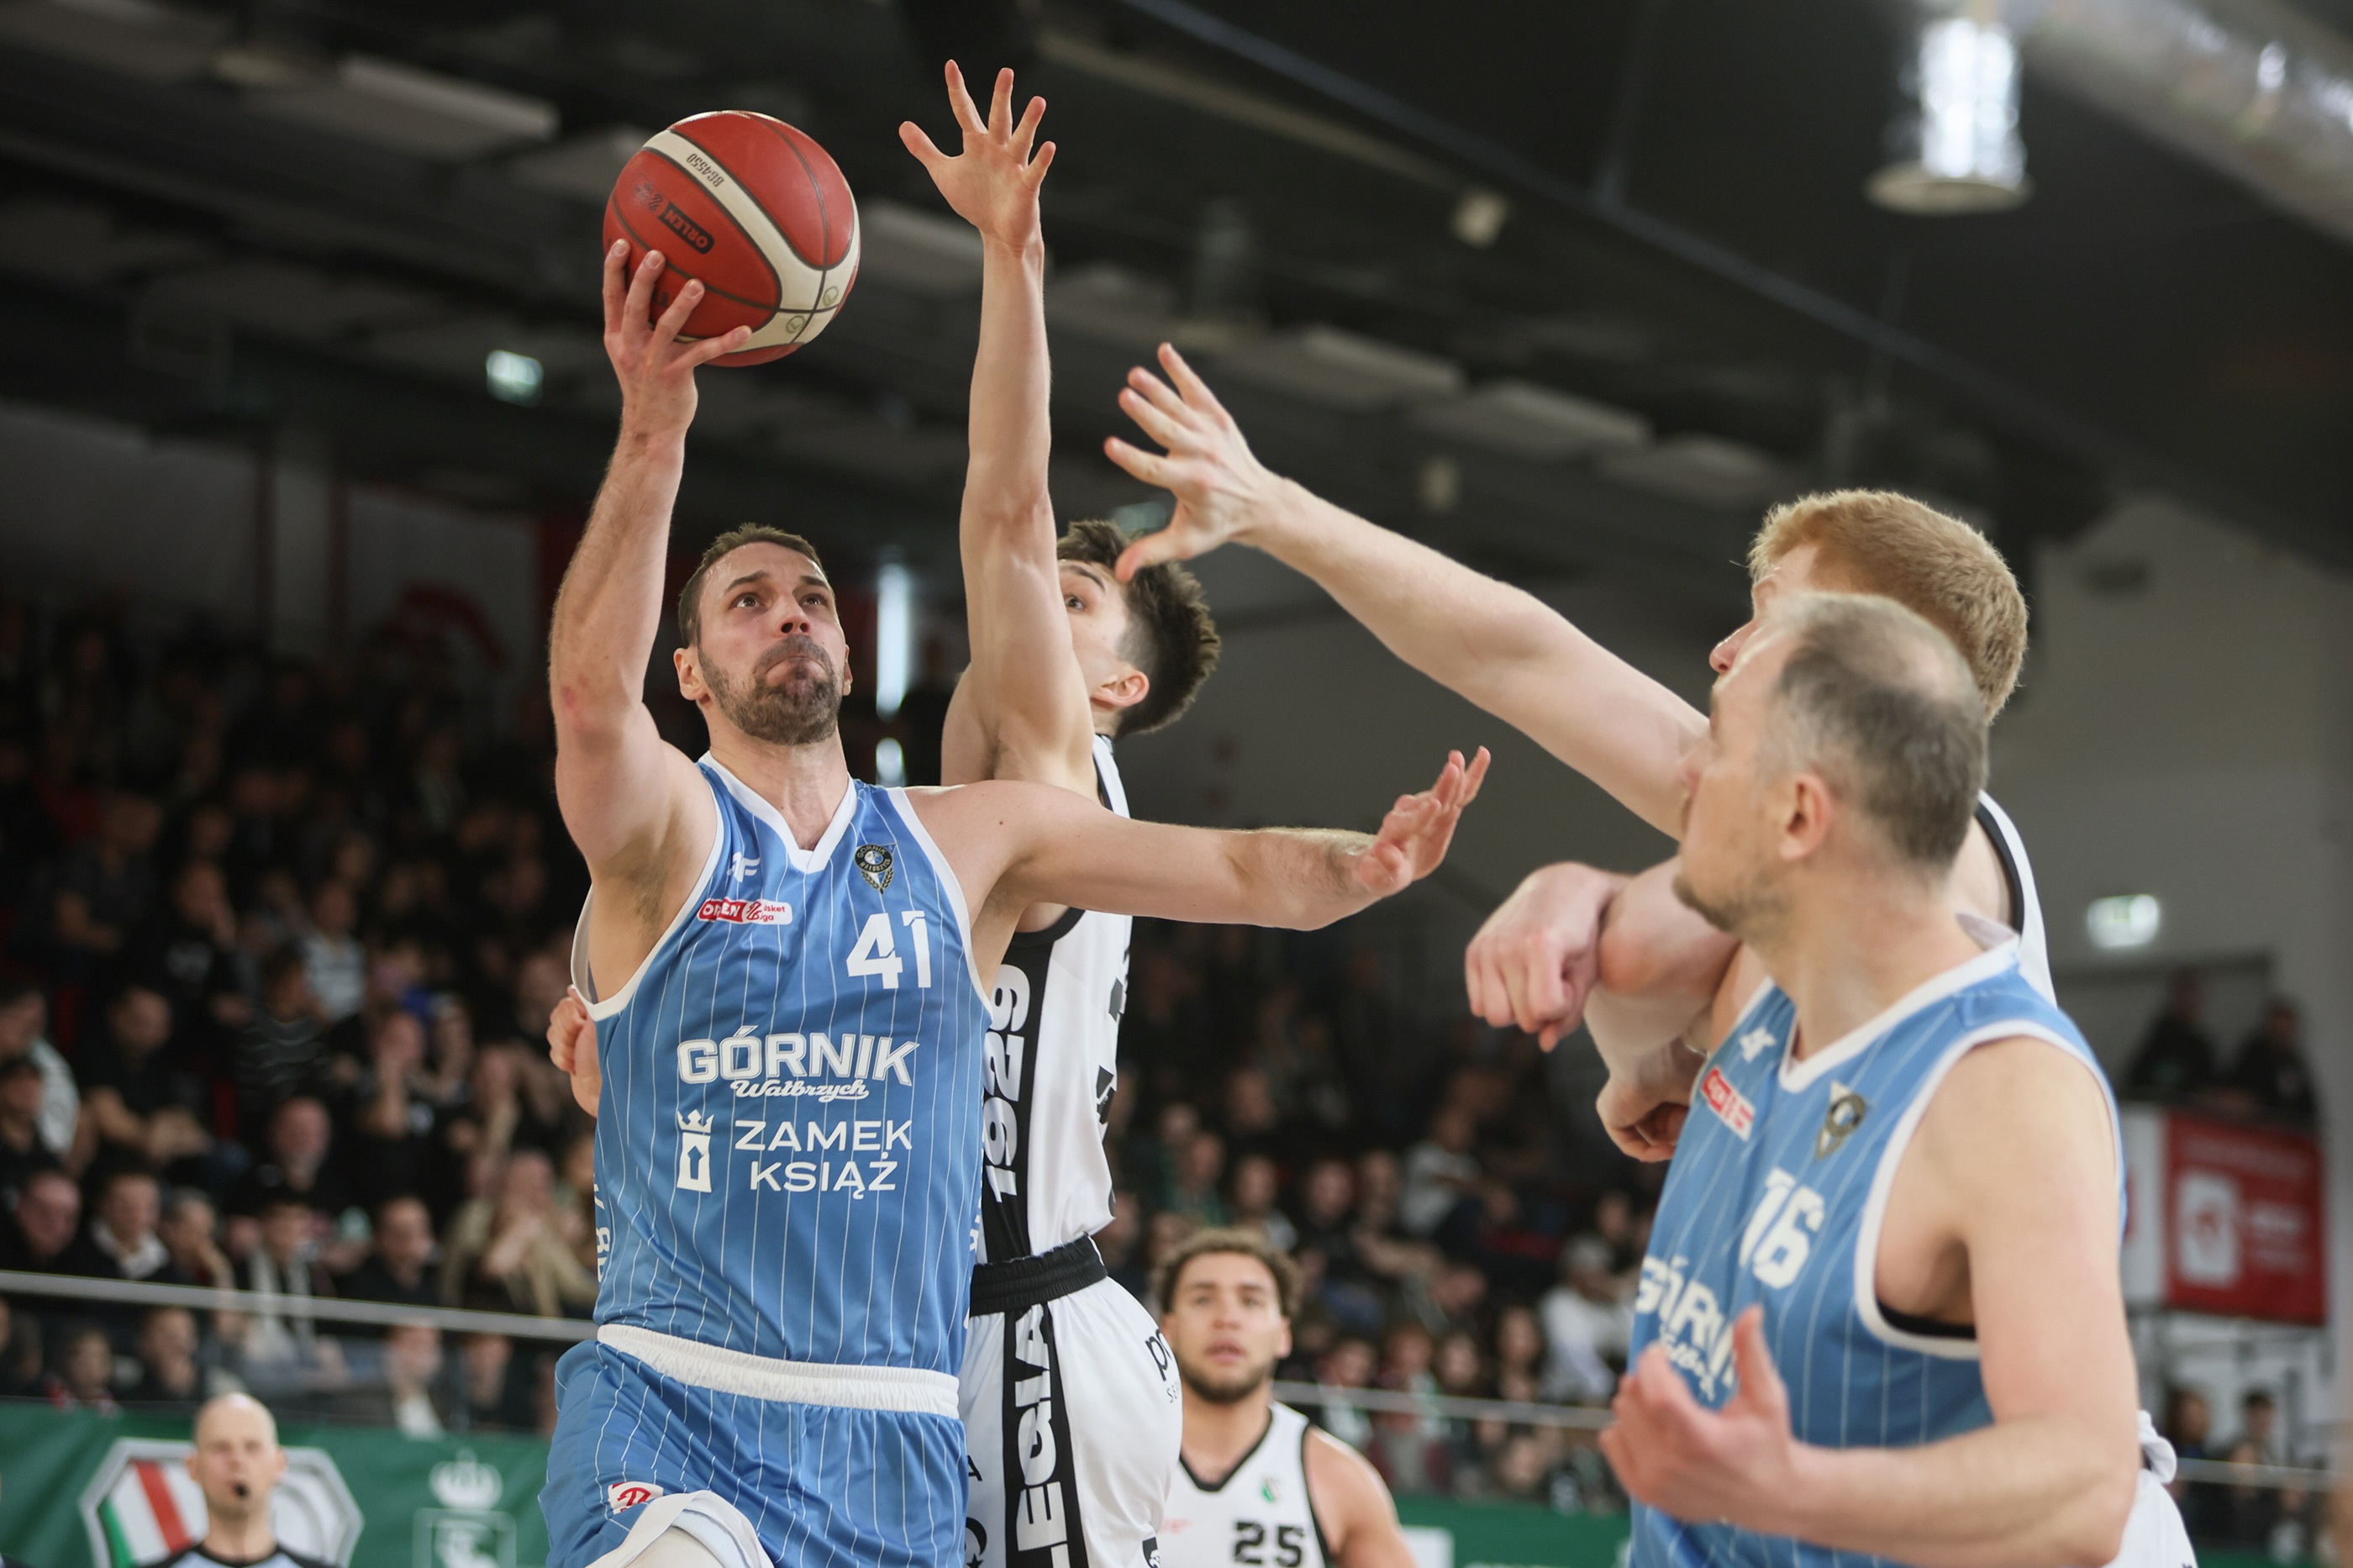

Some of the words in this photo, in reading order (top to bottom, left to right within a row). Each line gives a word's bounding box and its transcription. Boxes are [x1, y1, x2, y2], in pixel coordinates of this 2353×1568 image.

[686, 153, 725, 187] BG4550
[662, 208, 709, 249] ORLEN
[845, 910, 932, 990] 41
[677, 1025, 920, 1087] GÓRNIK
[730, 1078, 870, 1102] Wałbrzych
[982, 964, 1031, 1203] 1929
[734, 1119, 913, 1152] ZAMEK
[750, 1150, 899, 1200] KSIĄŻ
[1739, 1167, 1825, 1290] 16
[1235, 1520, 1305, 1568] 25
